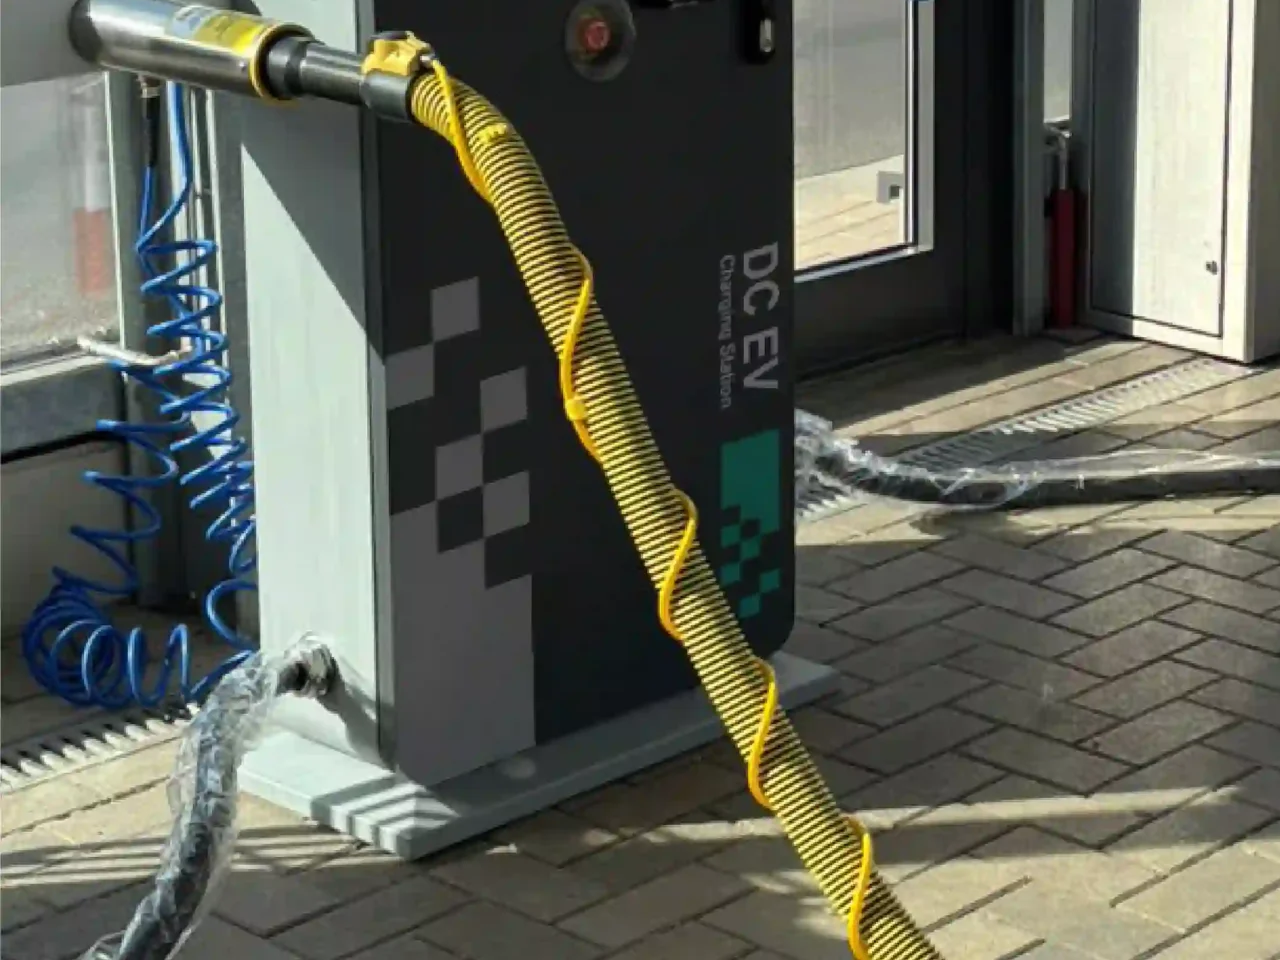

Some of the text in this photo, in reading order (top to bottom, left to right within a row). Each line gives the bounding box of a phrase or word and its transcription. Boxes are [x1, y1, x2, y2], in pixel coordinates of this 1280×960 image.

[718, 254, 736, 410] Charging Station
[743, 242, 780, 390] DC EV
